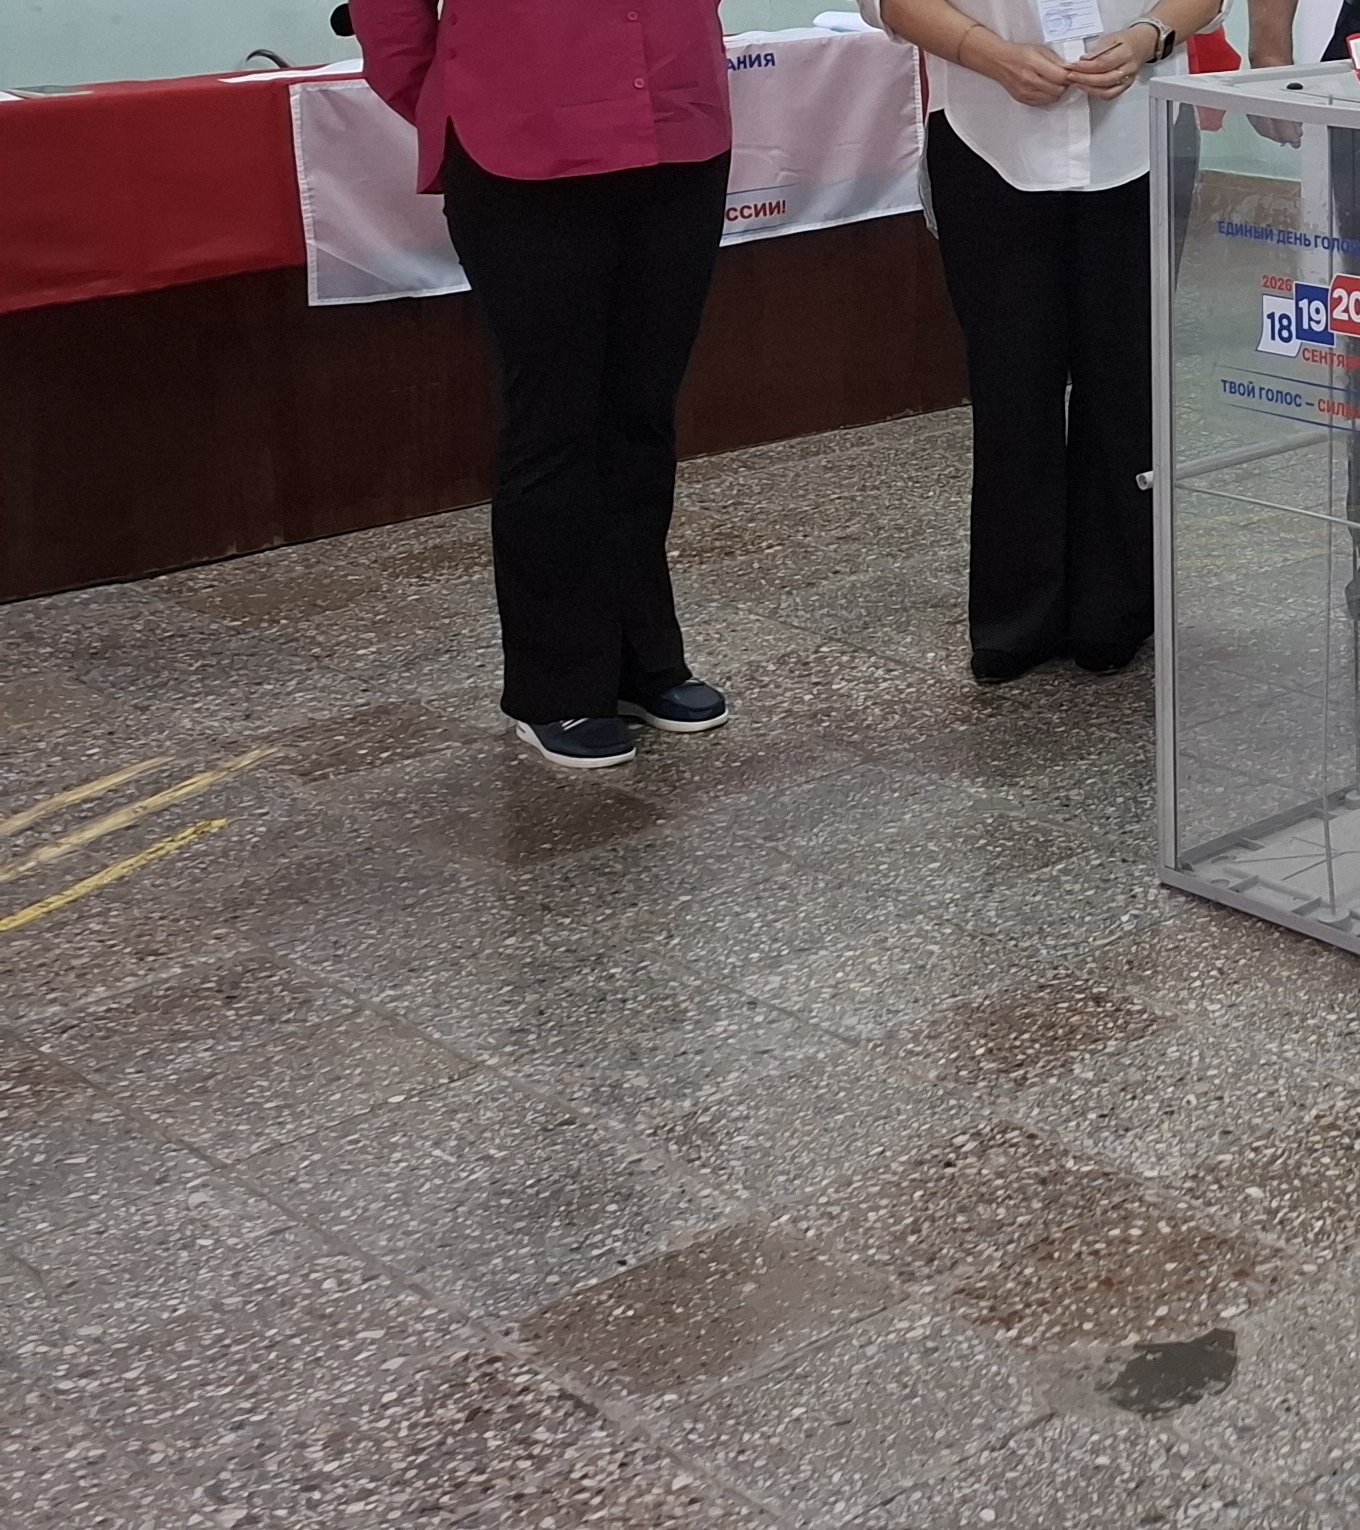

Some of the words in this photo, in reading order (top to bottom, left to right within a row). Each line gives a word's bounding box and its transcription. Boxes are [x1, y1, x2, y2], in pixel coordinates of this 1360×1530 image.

[727, 52, 776, 71] АНИЯ
[725, 200, 786, 221] ССИИ!
[1218, 221, 1274, 242] ЕДИНЫЙ
[1276, 229, 1311, 247] ДЕНЬ
[1262, 275, 1292, 292] 2026
[1266, 311, 1293, 343] 18
[1298, 298, 1327, 332] 19
[1221, 378, 1256, 398] ТВОЙ
[1259, 386, 1302, 408] ГОЛОС
[1318, 398, 1355, 418] СИЛ
